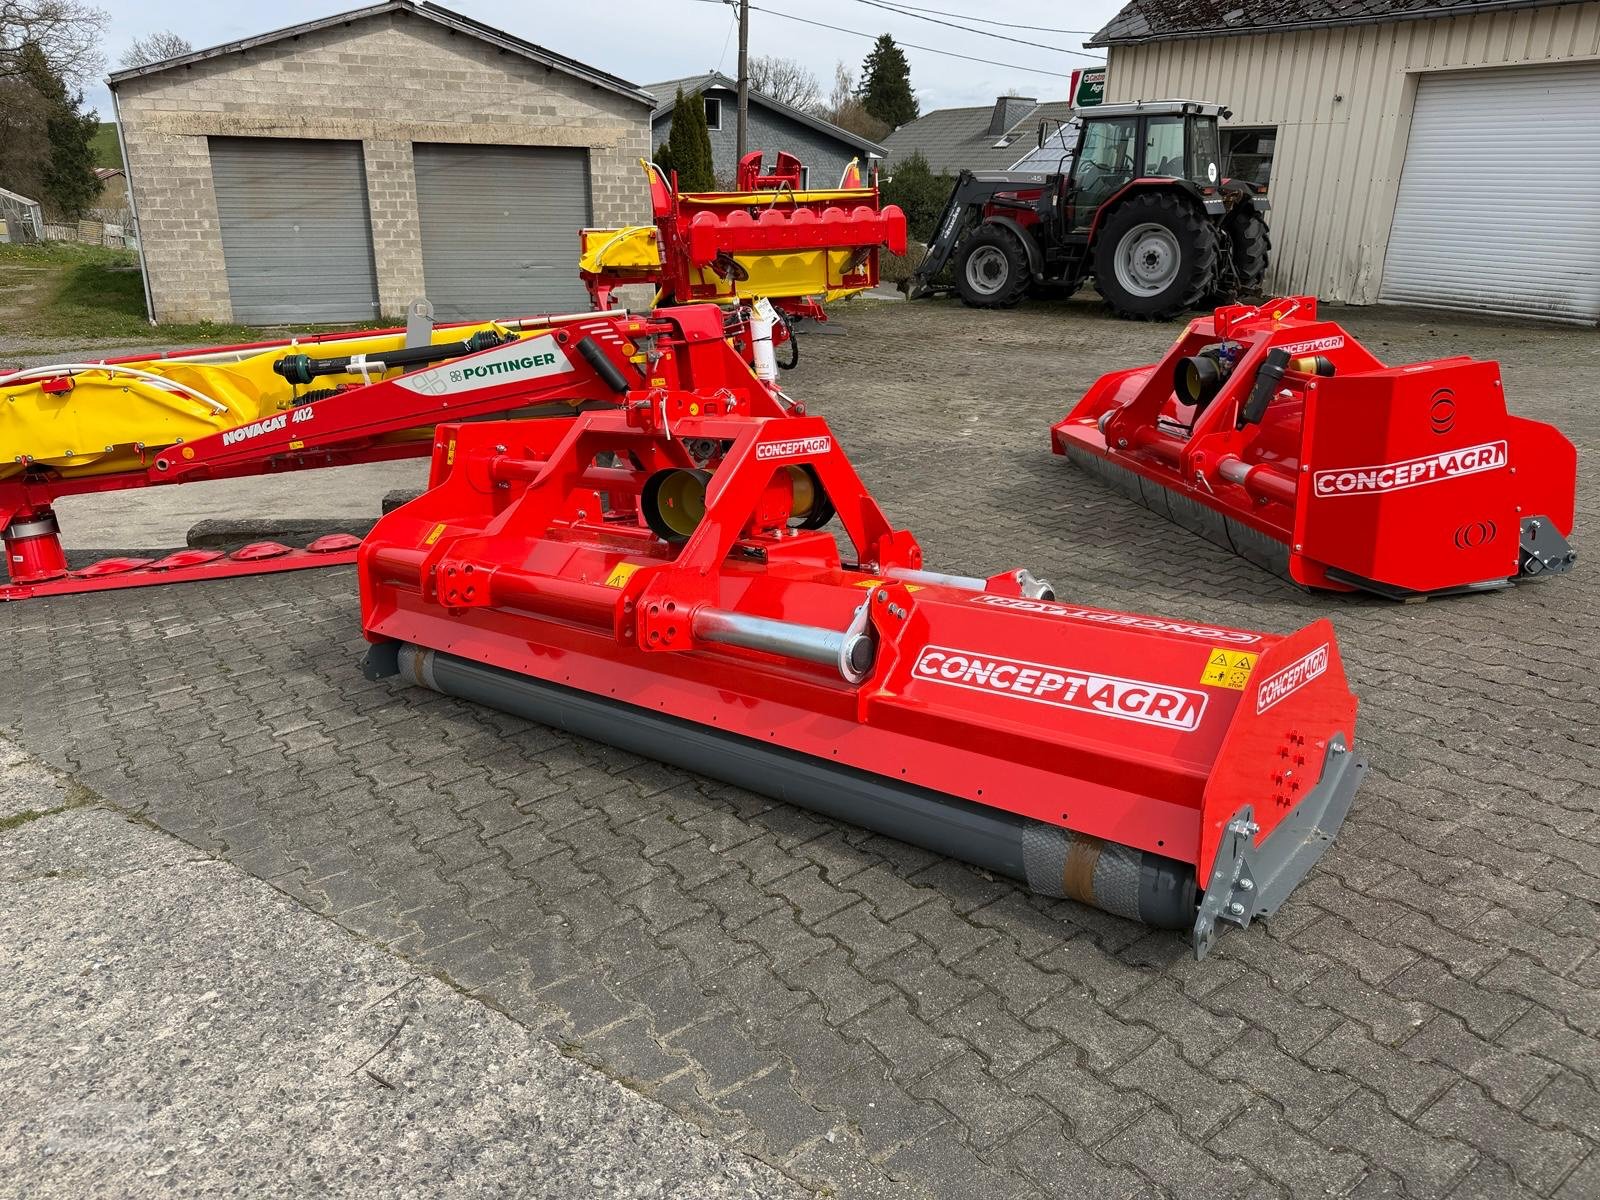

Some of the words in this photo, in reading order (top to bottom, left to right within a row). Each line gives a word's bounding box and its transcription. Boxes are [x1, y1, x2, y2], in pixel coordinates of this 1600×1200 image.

[1279, 335, 1344, 355] NCEPTAGRI
[222, 414, 287, 446] NOVACAT
[292, 407, 314, 423] 402
